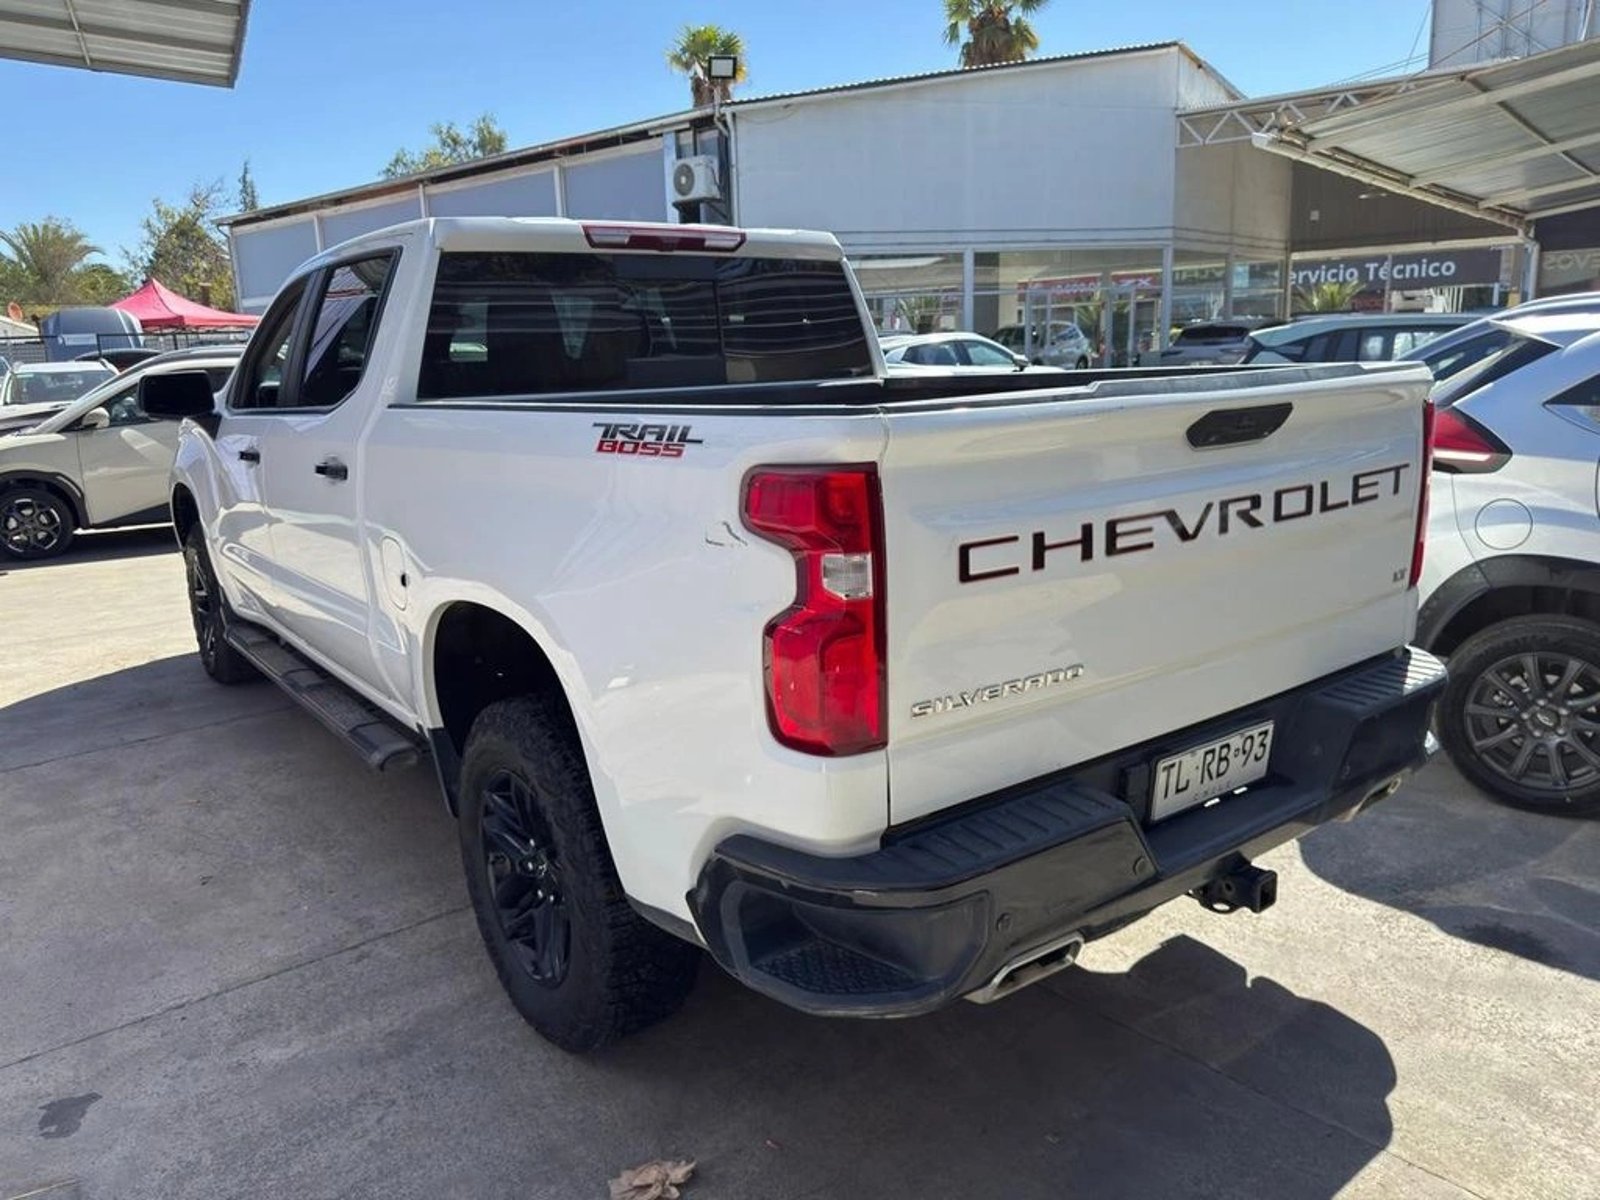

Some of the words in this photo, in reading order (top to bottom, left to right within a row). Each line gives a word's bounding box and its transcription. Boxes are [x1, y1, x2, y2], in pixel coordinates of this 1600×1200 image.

[1289, 263, 1358, 286] ervicio
[1365, 258, 1456, 282] Técnico
[592, 422, 704, 444] TRAIL
[596, 440, 686, 458] BOSS
[958, 463, 1410, 584] CHEVROLET
[911, 663, 1085, 719] SILVERADO
